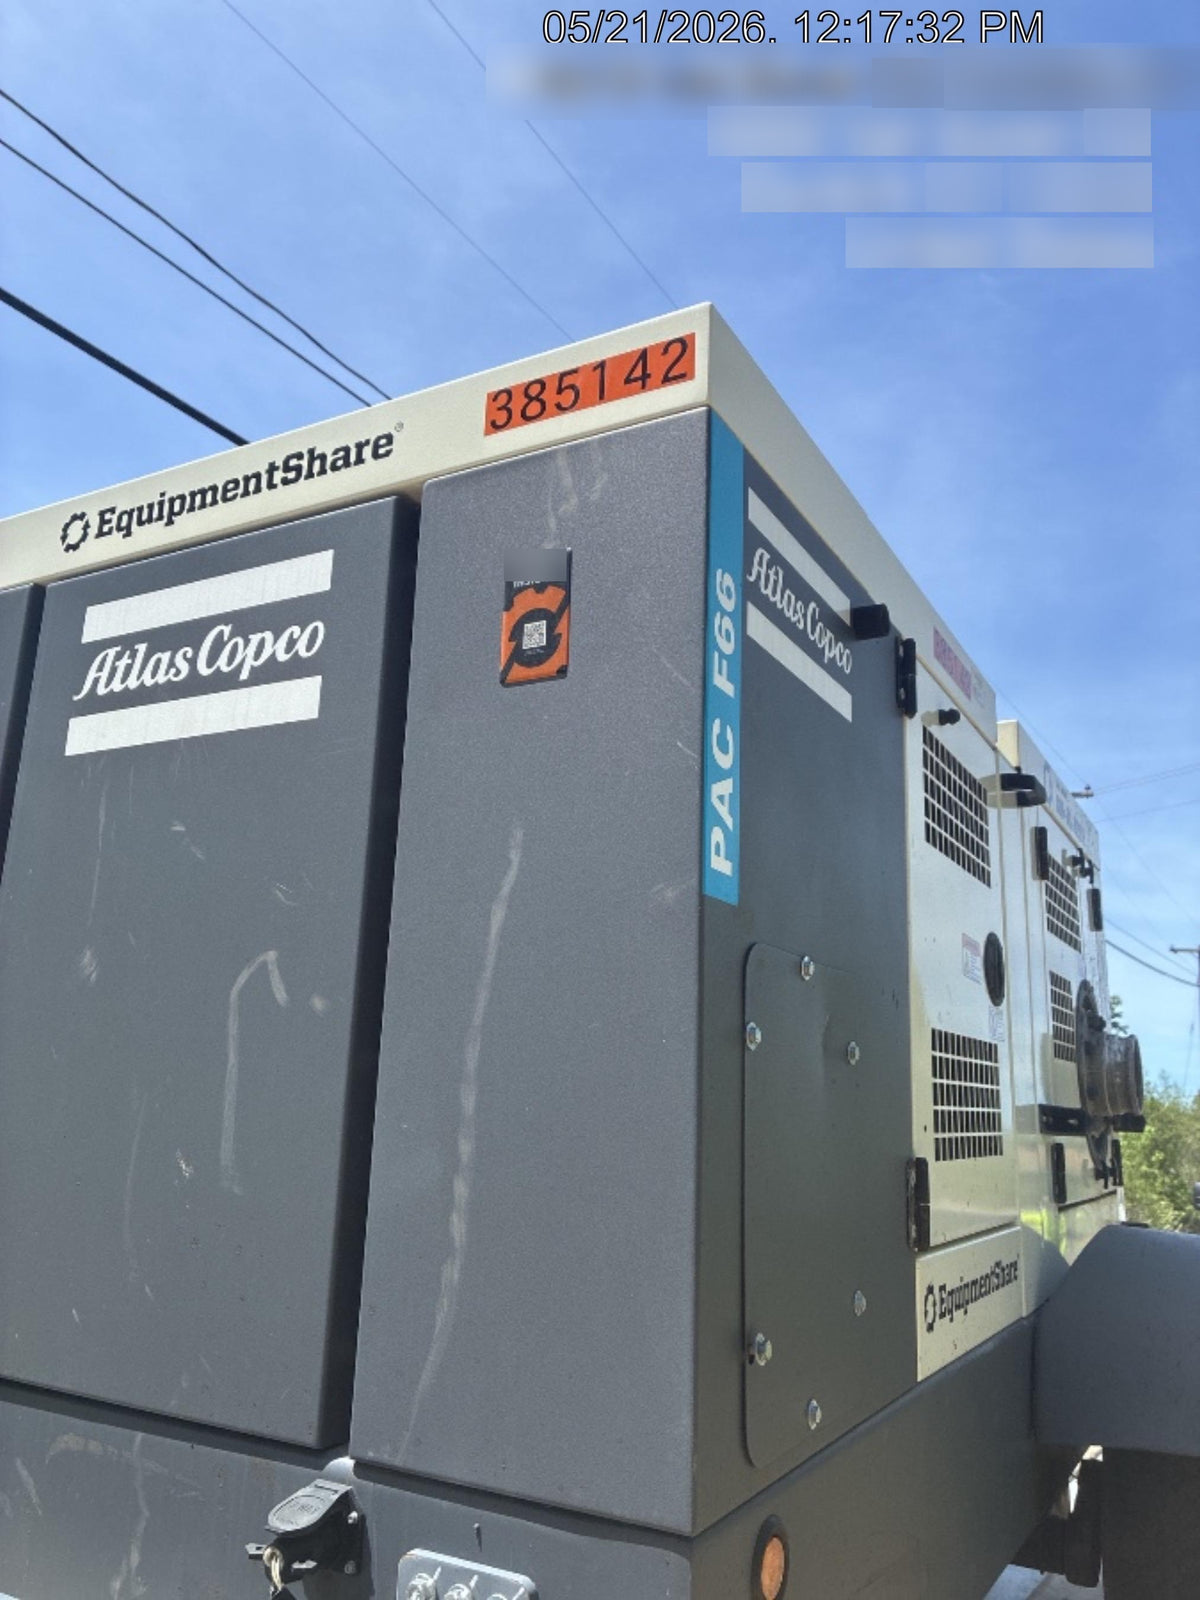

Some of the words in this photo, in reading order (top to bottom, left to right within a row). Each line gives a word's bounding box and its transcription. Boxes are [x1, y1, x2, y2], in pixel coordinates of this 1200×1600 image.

[490, 337, 689, 430] 385142
[94, 431, 394, 539] EquipmentShare
[712, 568, 737, 699] F66
[710, 717, 735, 877] PAC
